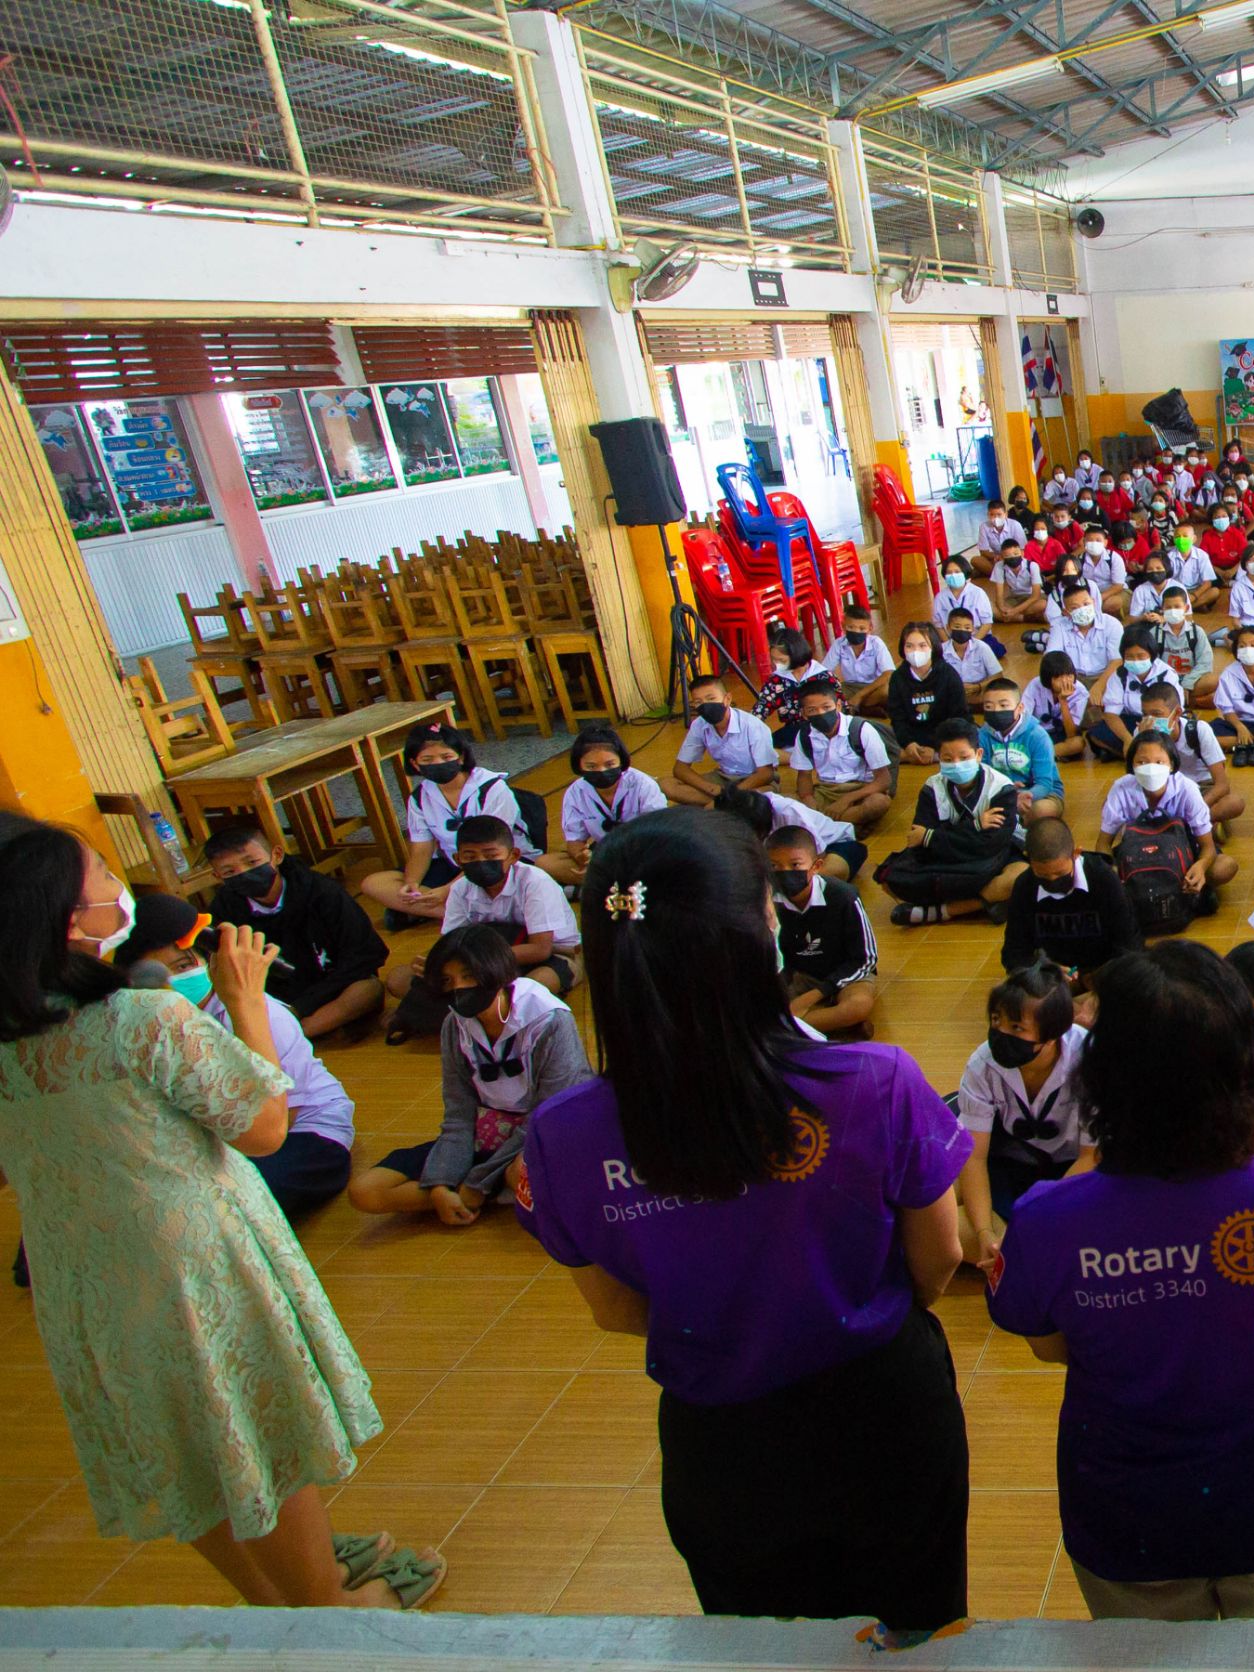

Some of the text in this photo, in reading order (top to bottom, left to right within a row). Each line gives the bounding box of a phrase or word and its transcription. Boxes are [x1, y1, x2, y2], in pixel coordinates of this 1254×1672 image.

[602, 1195, 685, 1223] District
[1079, 1244, 1201, 1278] Rotary
[1074, 1279, 1207, 1309] District 3340
